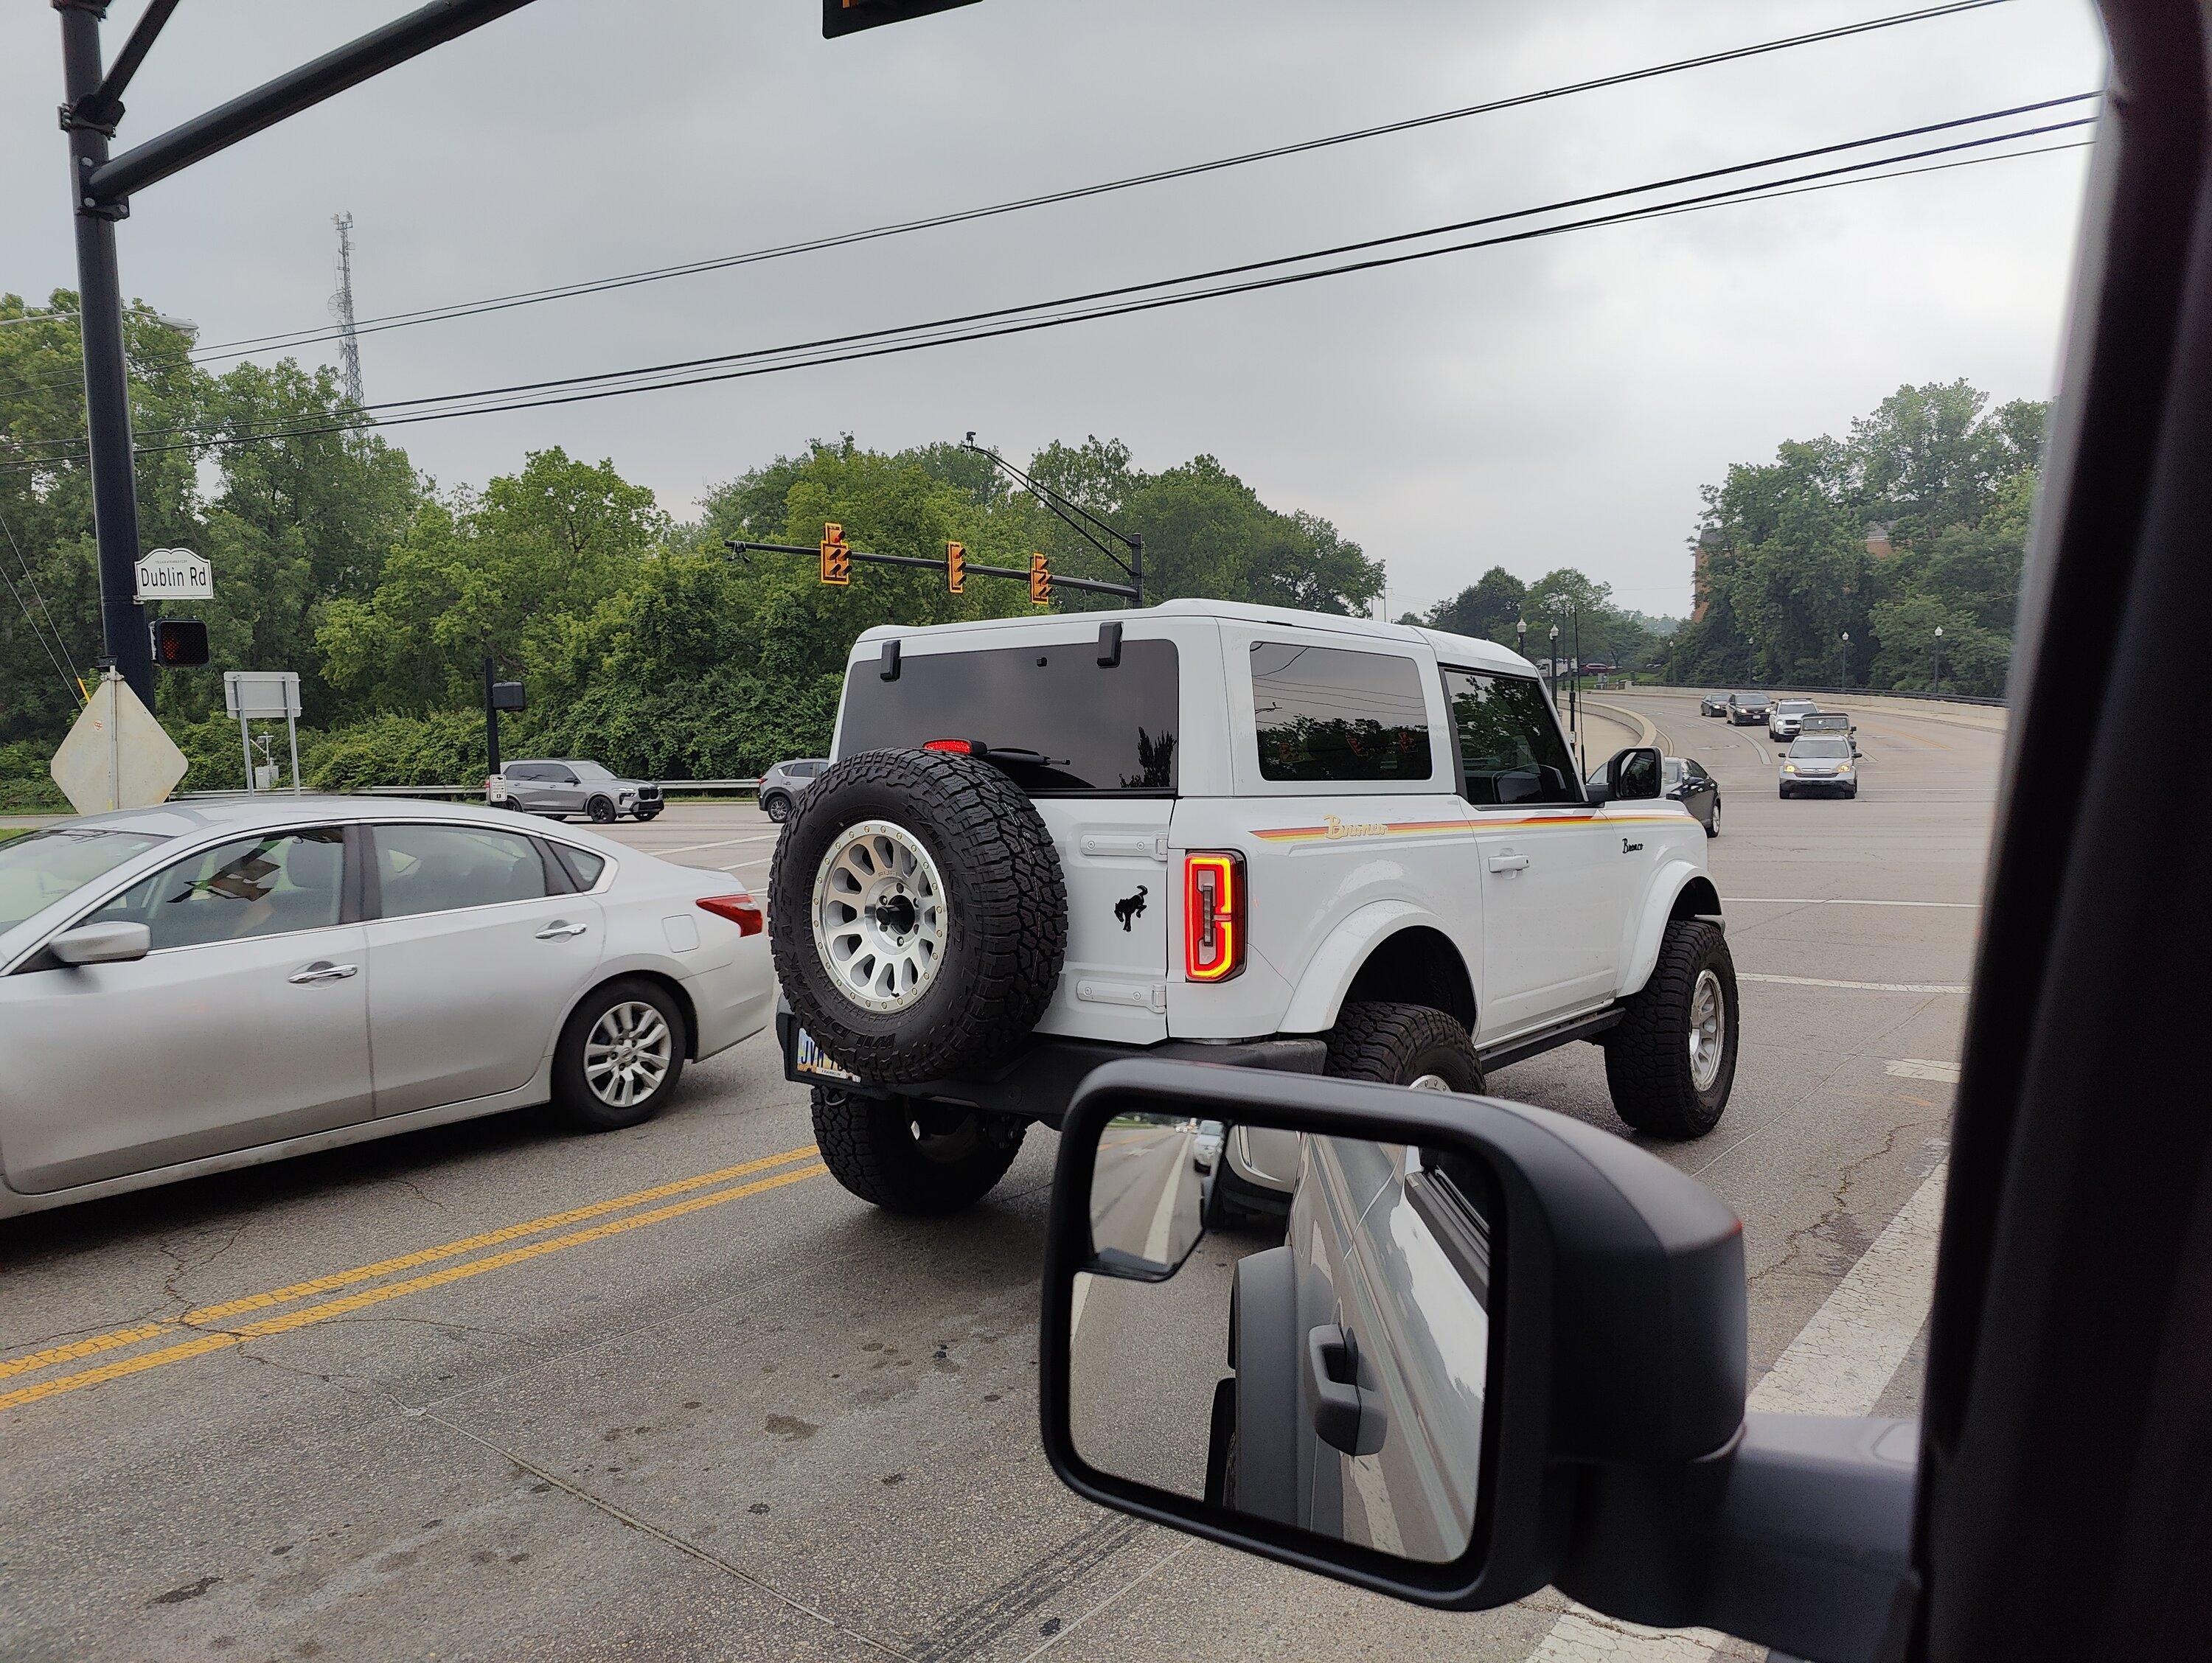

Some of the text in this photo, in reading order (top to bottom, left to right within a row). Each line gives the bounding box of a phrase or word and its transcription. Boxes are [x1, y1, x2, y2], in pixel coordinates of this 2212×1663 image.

[141, 566, 206, 587] Dublin Rd
[1323, 814, 1388, 840] Bronco
[1622, 837, 1644, 854] Bronco
